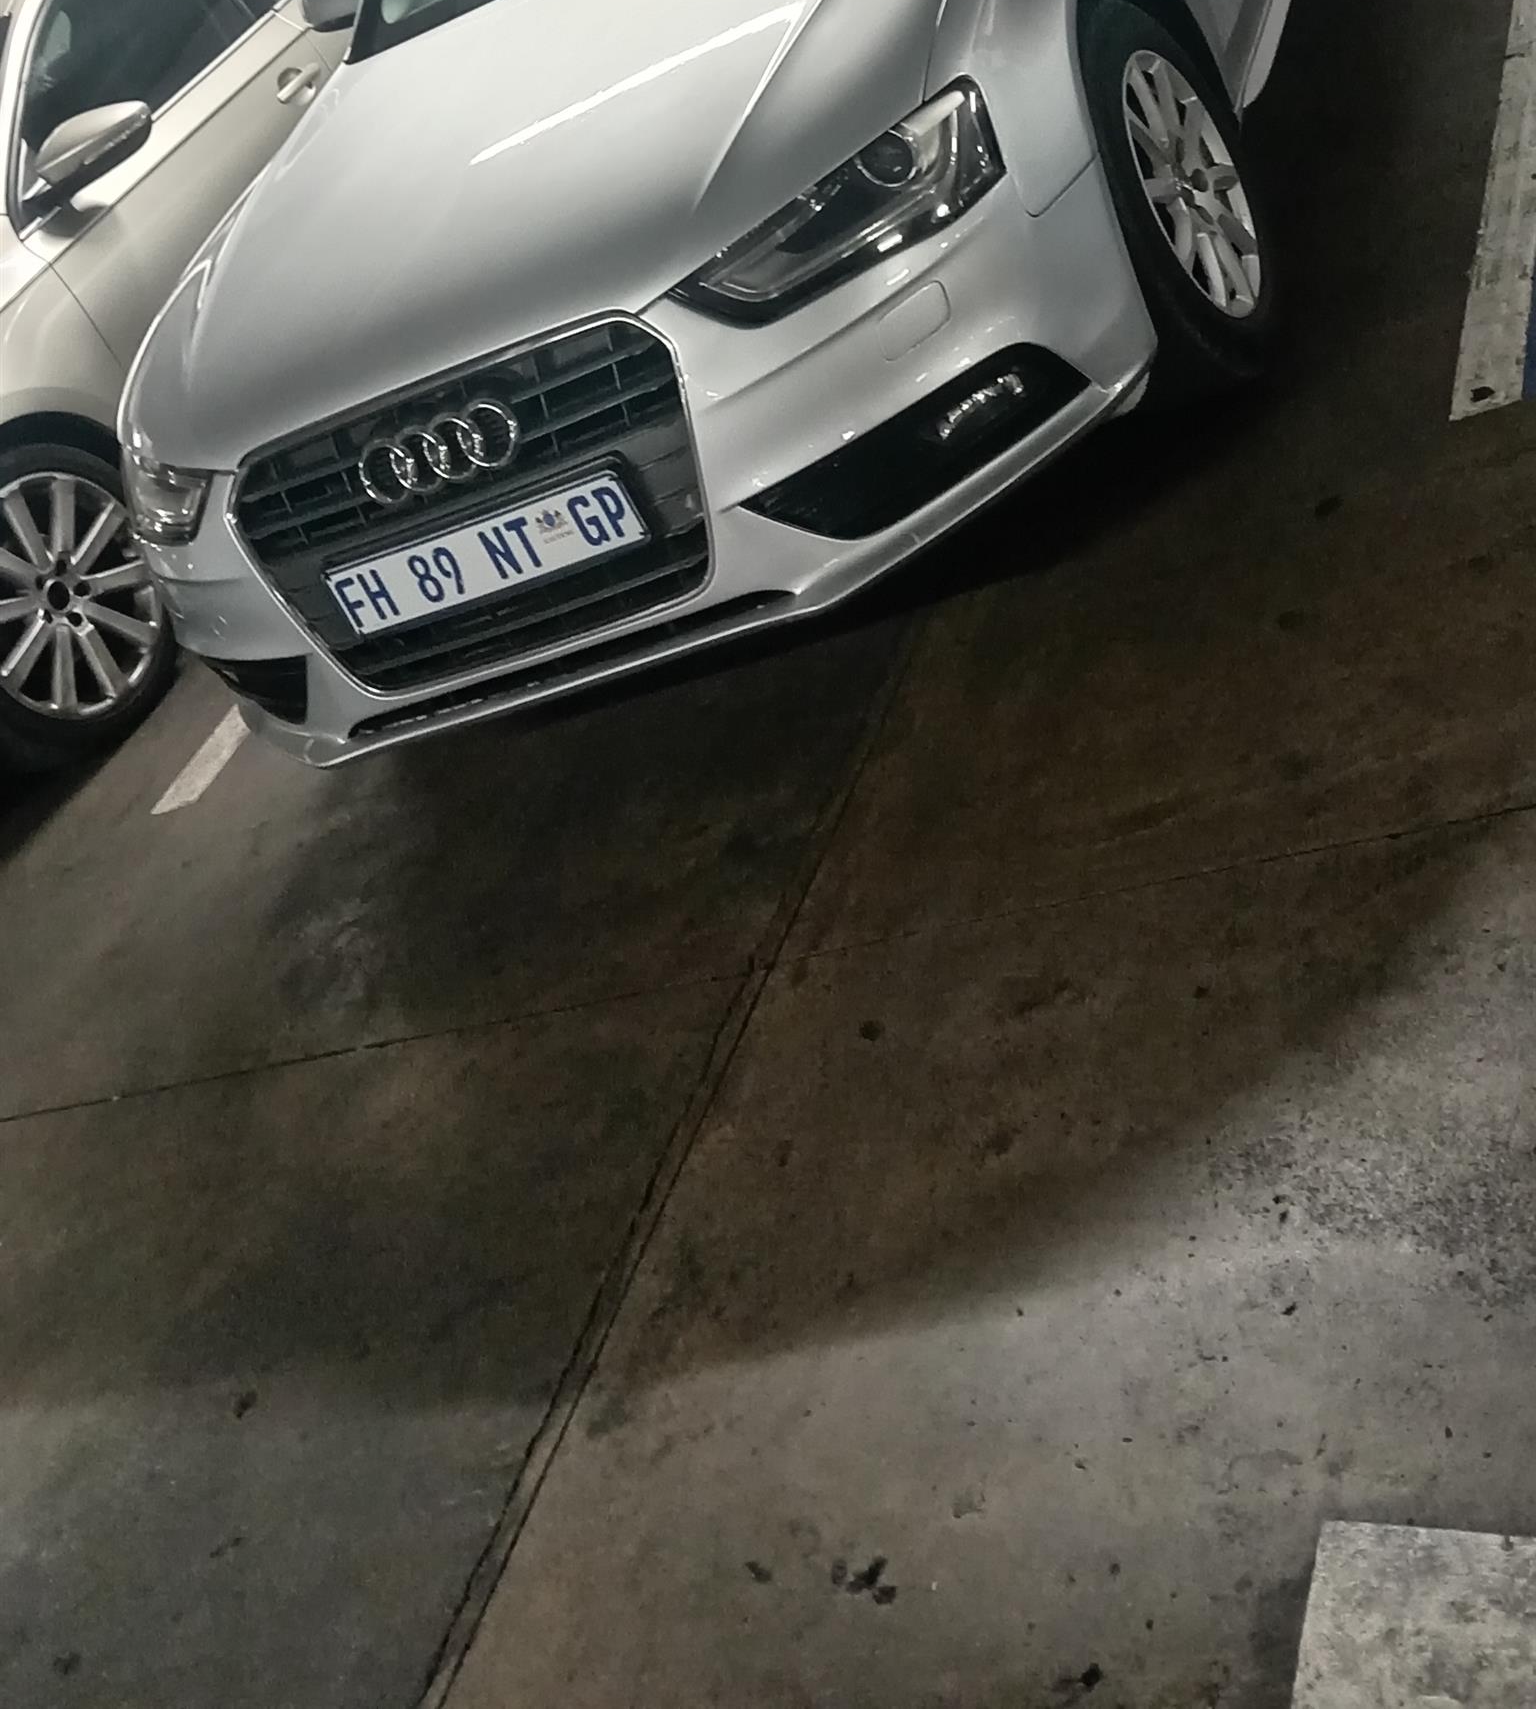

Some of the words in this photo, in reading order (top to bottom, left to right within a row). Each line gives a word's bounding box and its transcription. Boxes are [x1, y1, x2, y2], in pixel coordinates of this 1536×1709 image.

[335, 569, 400, 629] FH
[407, 546, 466, 603] 89
[477, 516, 543, 580] NT
[566, 485, 626, 546] GP
